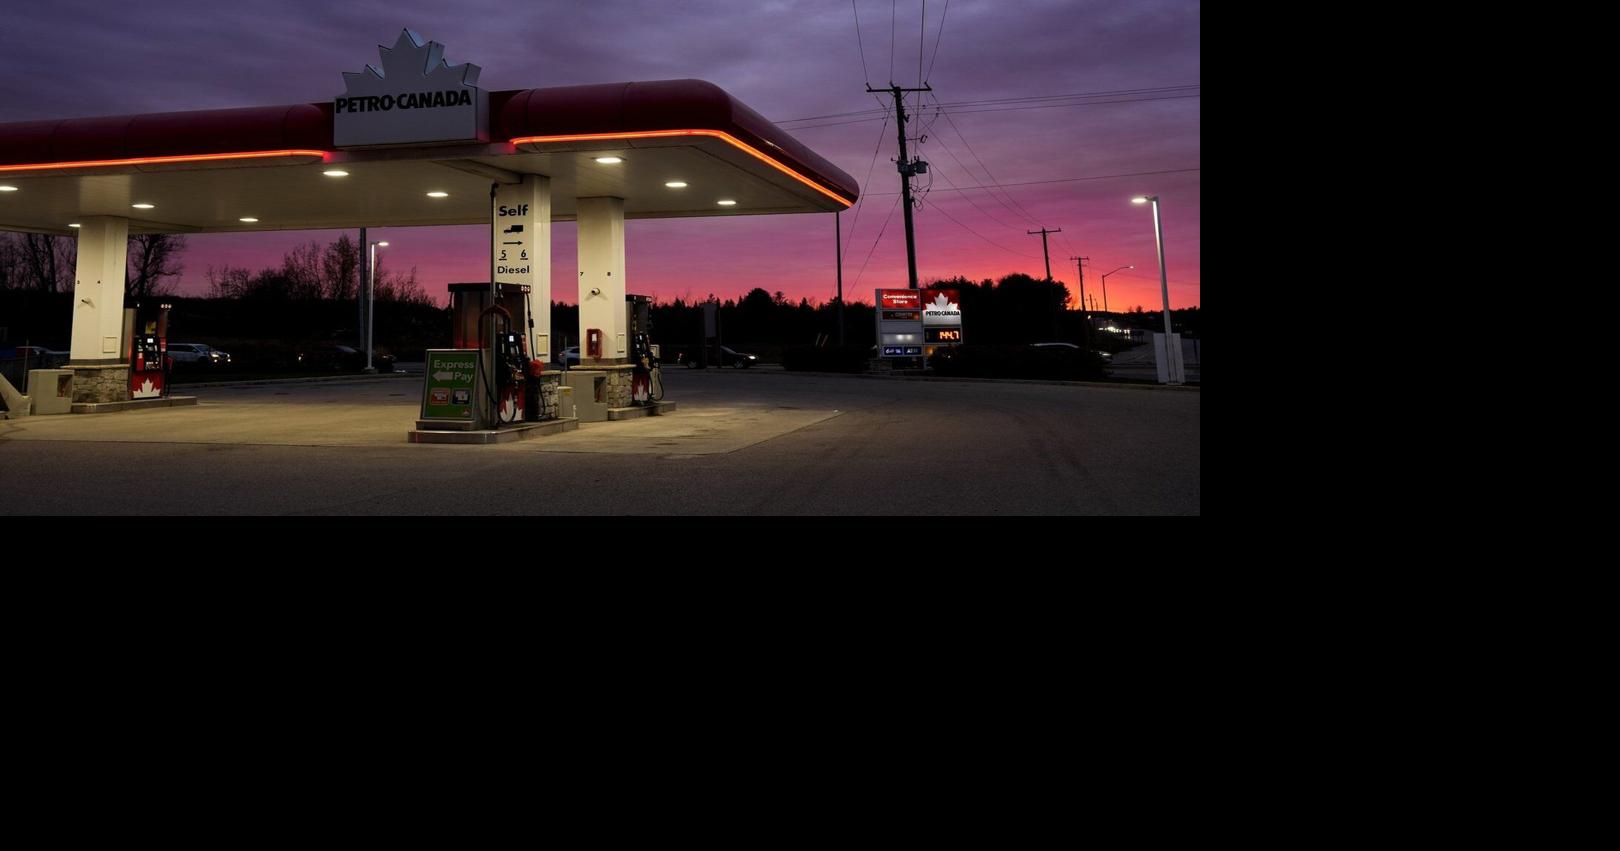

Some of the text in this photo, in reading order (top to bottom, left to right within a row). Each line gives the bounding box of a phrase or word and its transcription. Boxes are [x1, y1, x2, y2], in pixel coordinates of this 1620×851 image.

[499, 204, 529, 217] Self
[501, 249, 527, 259] 5 6
[497, 265, 530, 274] Diesel
[434, 359, 474, 370] Express
[454, 371, 474, 383] Pay
